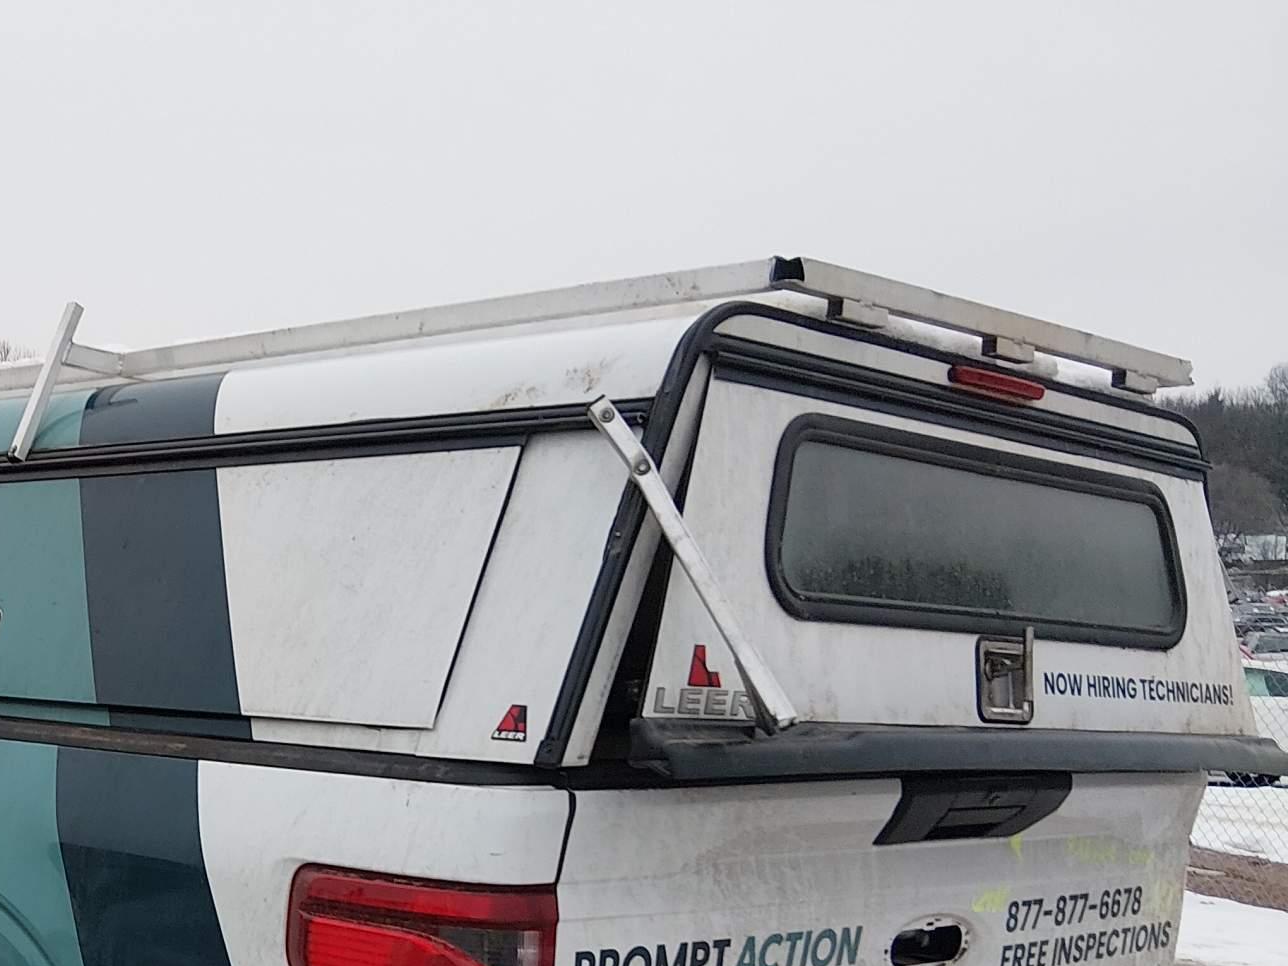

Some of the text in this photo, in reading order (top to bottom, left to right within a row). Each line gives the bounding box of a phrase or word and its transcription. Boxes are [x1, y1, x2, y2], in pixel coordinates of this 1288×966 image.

[653, 686, 754, 719] LEER
[1043, 672, 1234, 706] NOW HIRING TECHNICIANS!
[1005, 885, 1144, 933] 877-877-6678
[1051, 920, 1172, 966] INSPECTIONS
